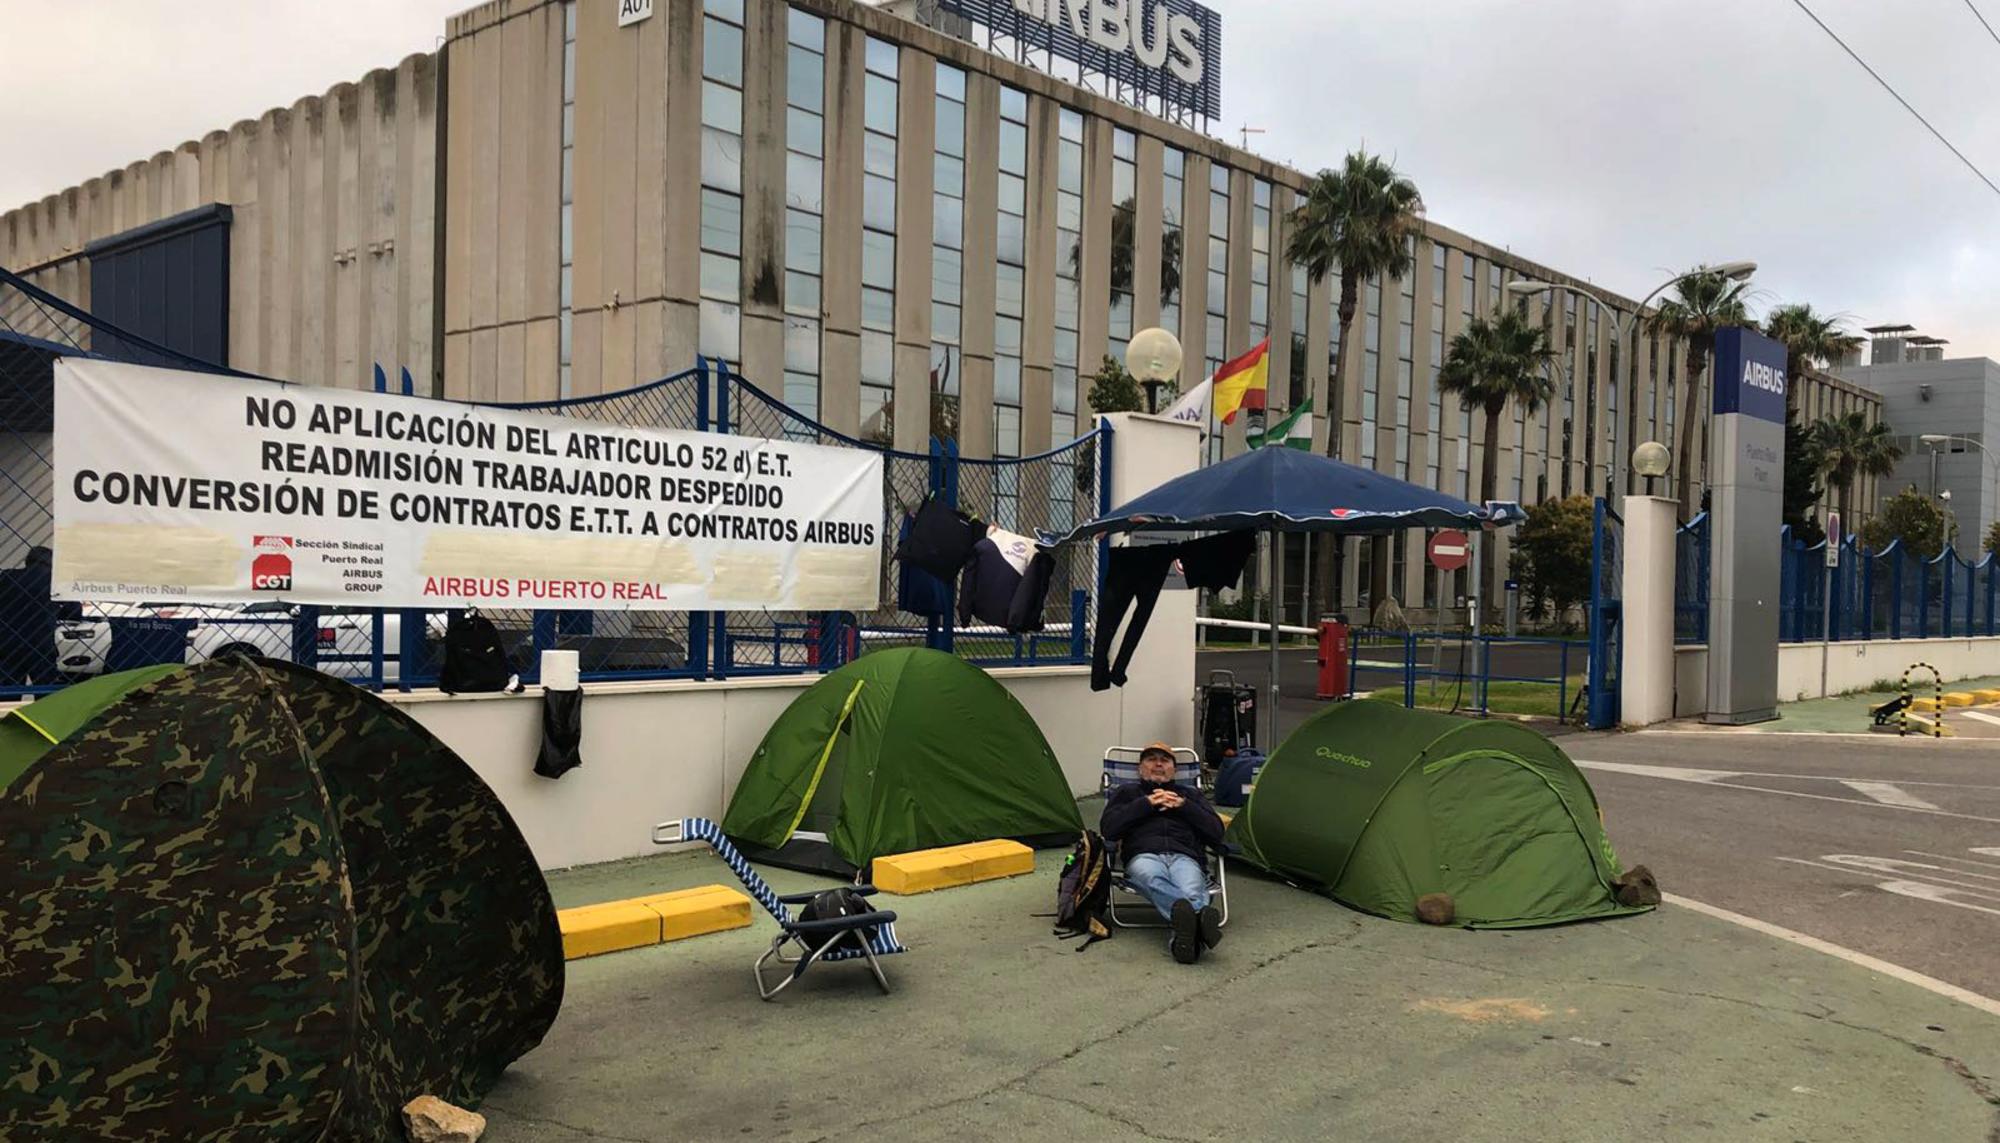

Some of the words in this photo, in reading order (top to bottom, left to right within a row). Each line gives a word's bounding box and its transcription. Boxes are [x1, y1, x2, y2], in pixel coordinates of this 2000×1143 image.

[1012, 0, 1201, 84] BUS
[1743, 360, 1784, 394] AIRBUS
[246, 396, 296, 429] NO
[308, 404, 495, 449] APLICACIÓN
[506, 425, 560, 456] DEL
[566, 431, 693, 468] ARTICULO
[701, 446, 728, 472] 52
[733, 449, 752, 480] d)
[758, 453, 792, 477] E.T.
[261, 440, 463, 485] READMISIÓN
[473, 460, 651, 500] TRABAJADOR
[660, 476, 783, 509] DESPEDIDO
[73, 469, 324, 517] CONVERSIÓN
[337, 489, 379, 520] DE
[390, 493, 561, 531] CONTRATOS
[570, 507, 633, 535] E.T.T.
[641, 509, 659, 536] A
[667, 511, 798, 543] CONTRATOS
[803, 521, 875, 546] AIRBUS
[295, 538, 339, 549] Sección
[342, 541, 383, 551] Sindical
[322, 554, 358, 564] Puerto
[361, 556, 383, 565] Real
[256, 574, 291, 589] CGT
[342, 569, 383, 578] AIRBUS
[72, 582, 113, 593] Airbus
[118, 583, 158, 594] Puerto
[161, 584, 187, 595] Real
[345, 583, 383, 592] GROUP
[423, 576, 510, 598] AIRBUS
[518, 578, 605, 599] PUERTO
[613, 582, 667, 600] REAL
